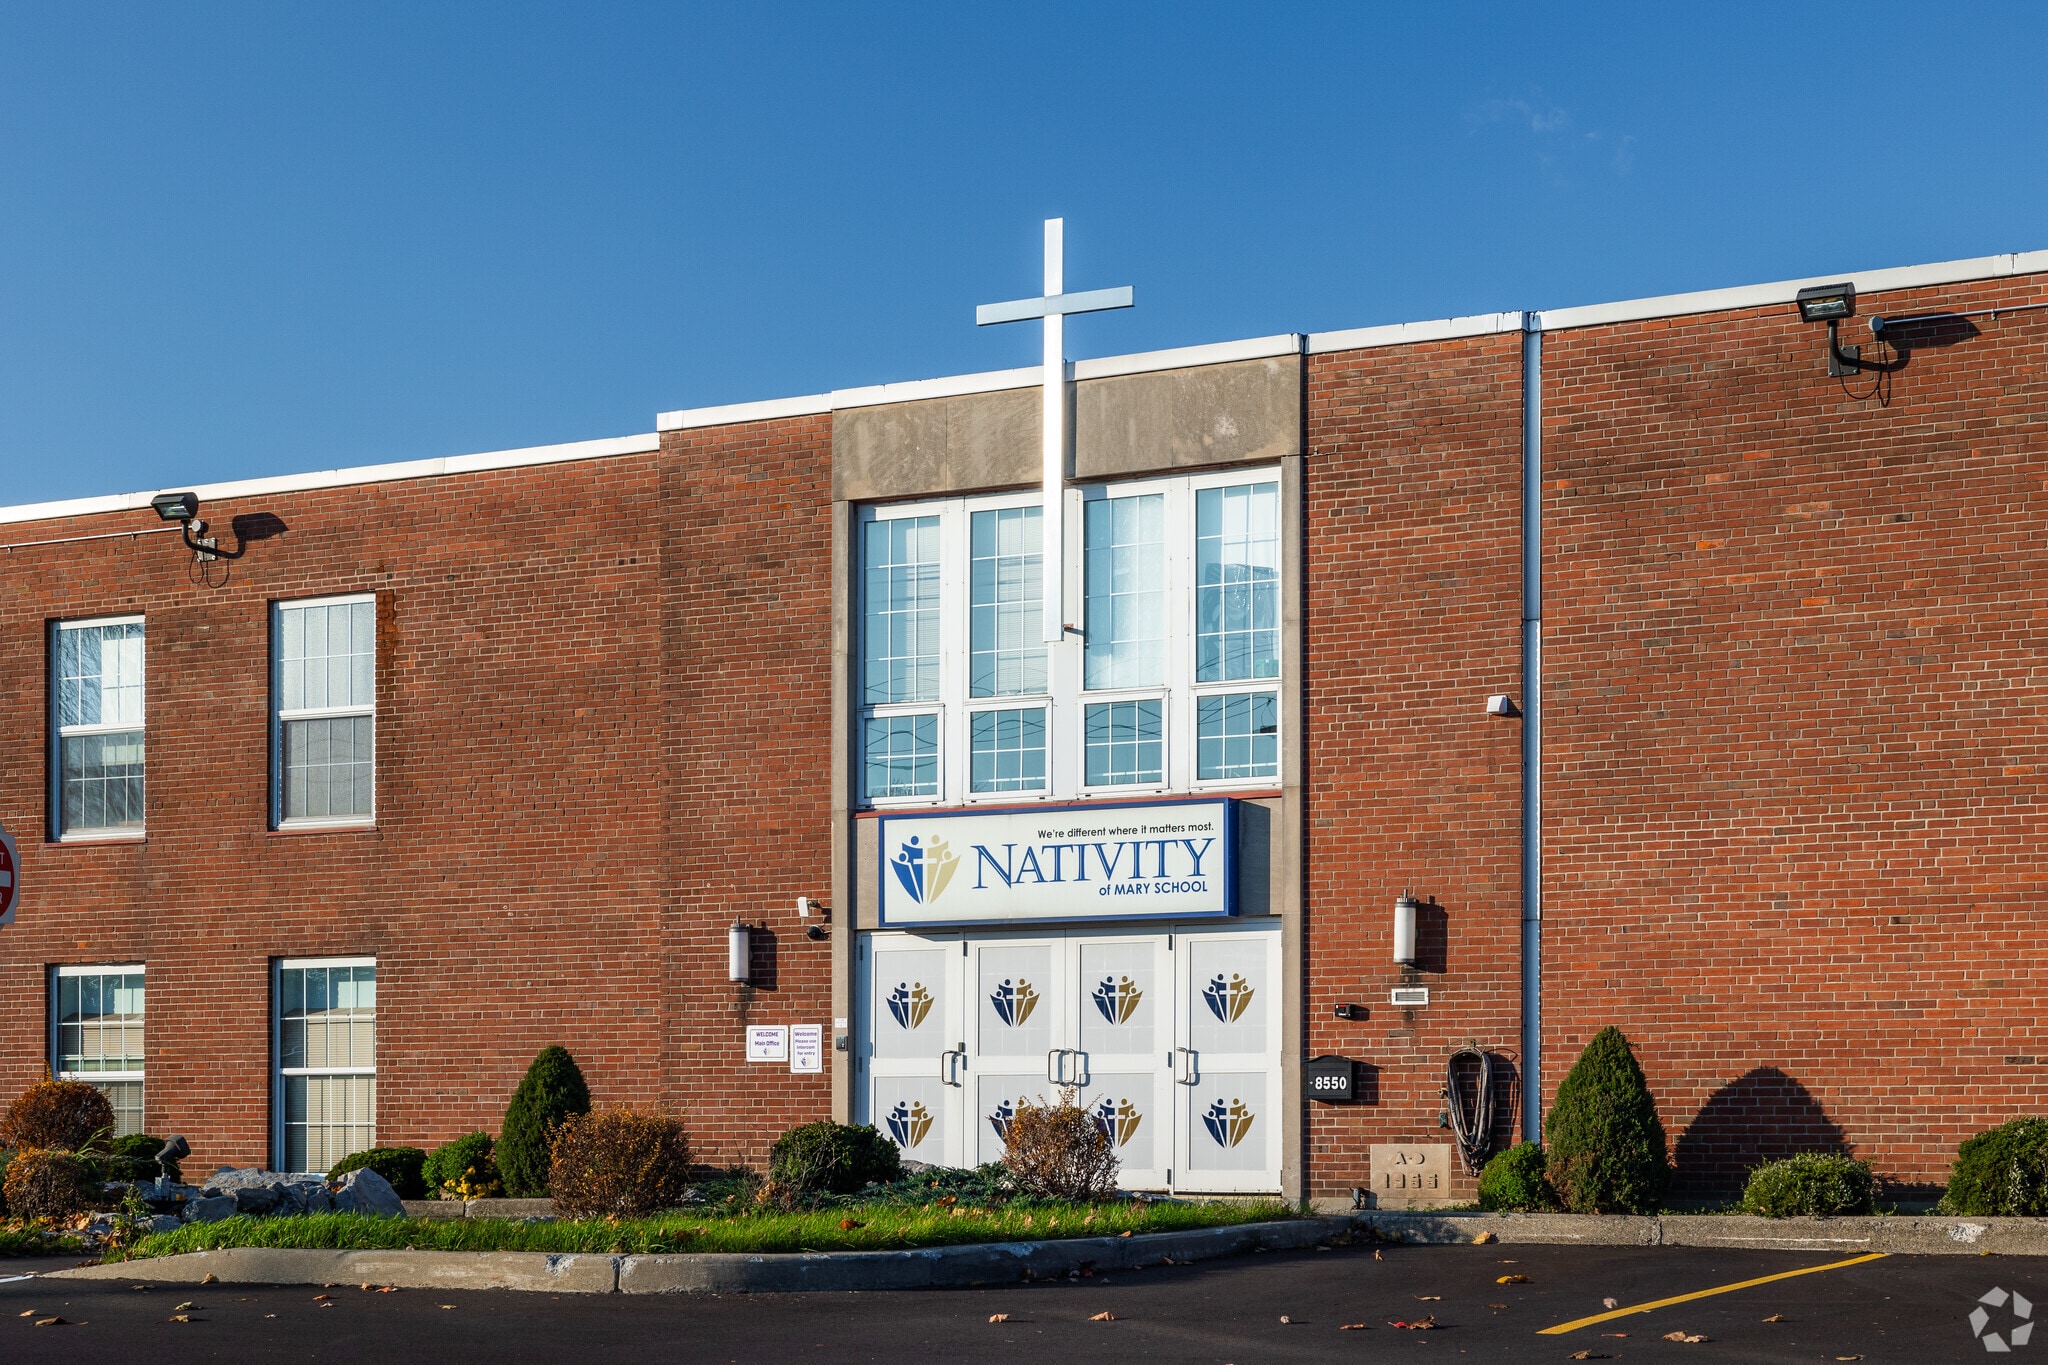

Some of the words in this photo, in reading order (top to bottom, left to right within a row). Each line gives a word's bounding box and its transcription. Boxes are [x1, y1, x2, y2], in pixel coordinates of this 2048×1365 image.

[1037, 829, 1065, 839] We're
[1067, 827, 1106, 838] different
[1108, 826, 1138, 836] where
[1141, 825, 1147, 835] it
[1149, 823, 1186, 834] matters
[1188, 821, 1214, 832] most.
[970, 837, 1216, 889] NATIVITY
[1099, 884, 1111, 896] of
[1114, 883, 1151, 895] MARY
[1154, 880, 1208, 894] SCHOOL
[1315, 1076, 1347, 1090] 8550
